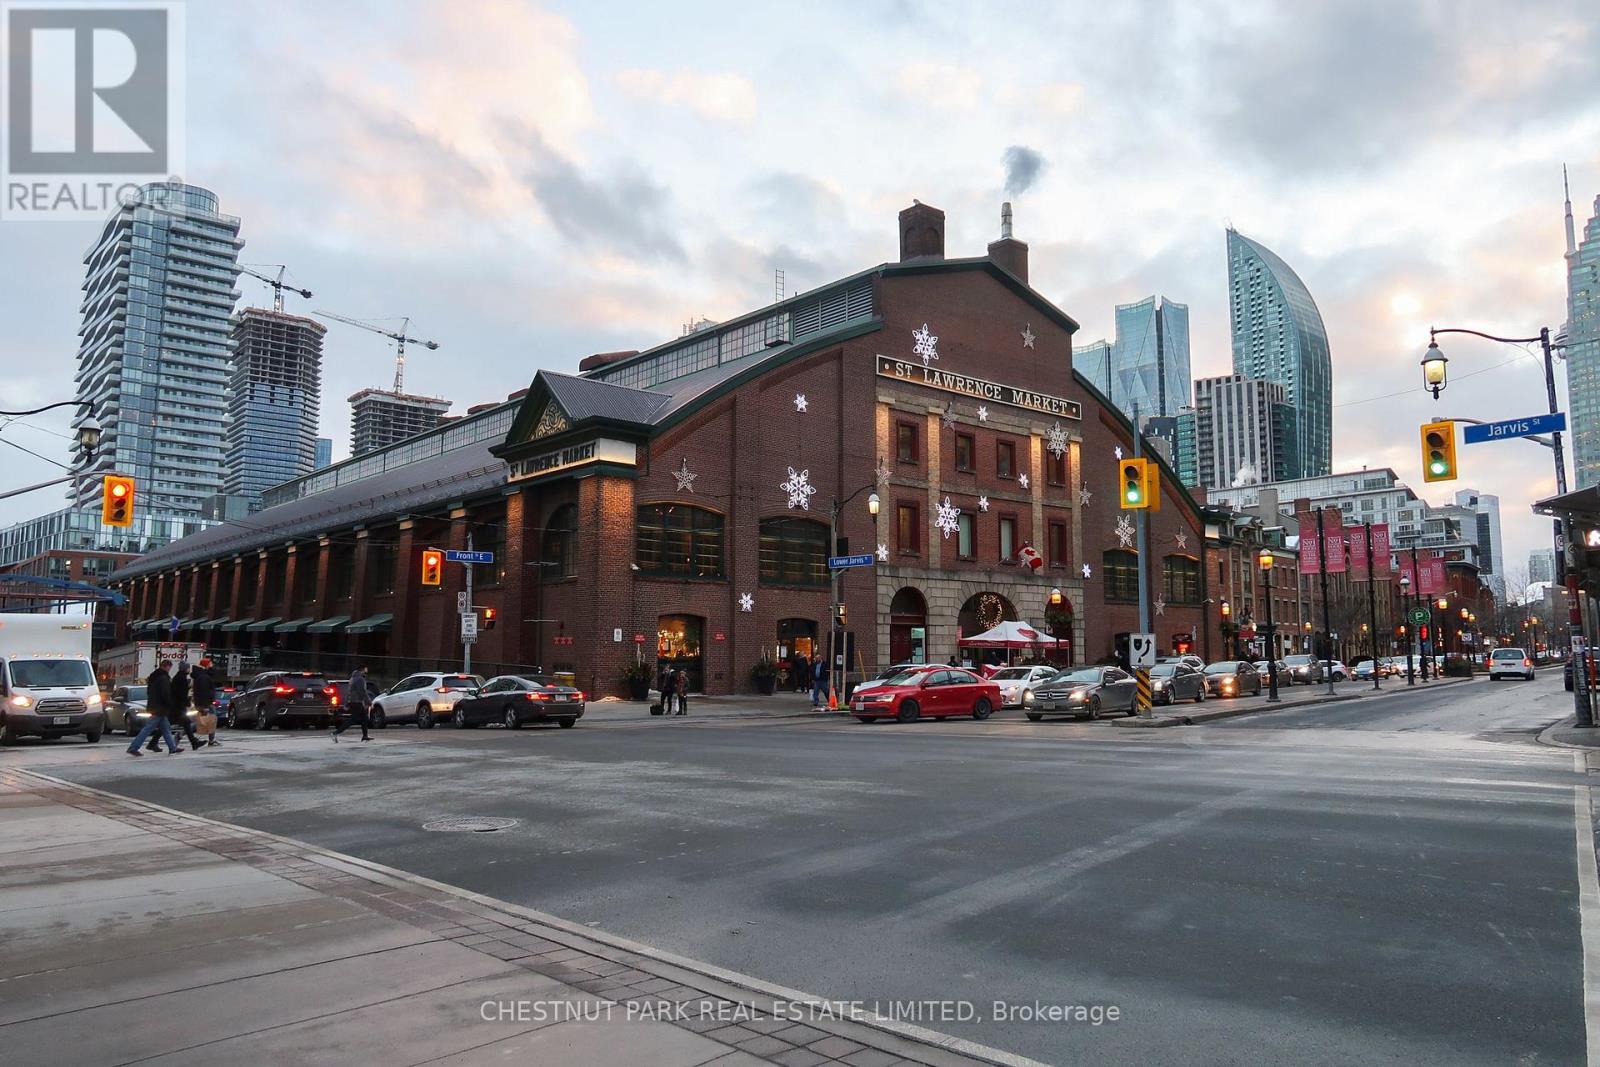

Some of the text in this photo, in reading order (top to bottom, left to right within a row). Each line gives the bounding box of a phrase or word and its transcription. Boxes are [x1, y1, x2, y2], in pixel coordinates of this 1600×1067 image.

[923, 368, 1002, 399] LAWRENCE
[1012, 389, 1068, 414] MARKET
[1487, 421, 1529, 437] Jarvis
[562, 441, 597, 466] MARKET
[833, 558, 849, 566] Lower
[849, 557, 864, 565] Jarvis
[1415, 611, 1424, 620] P
